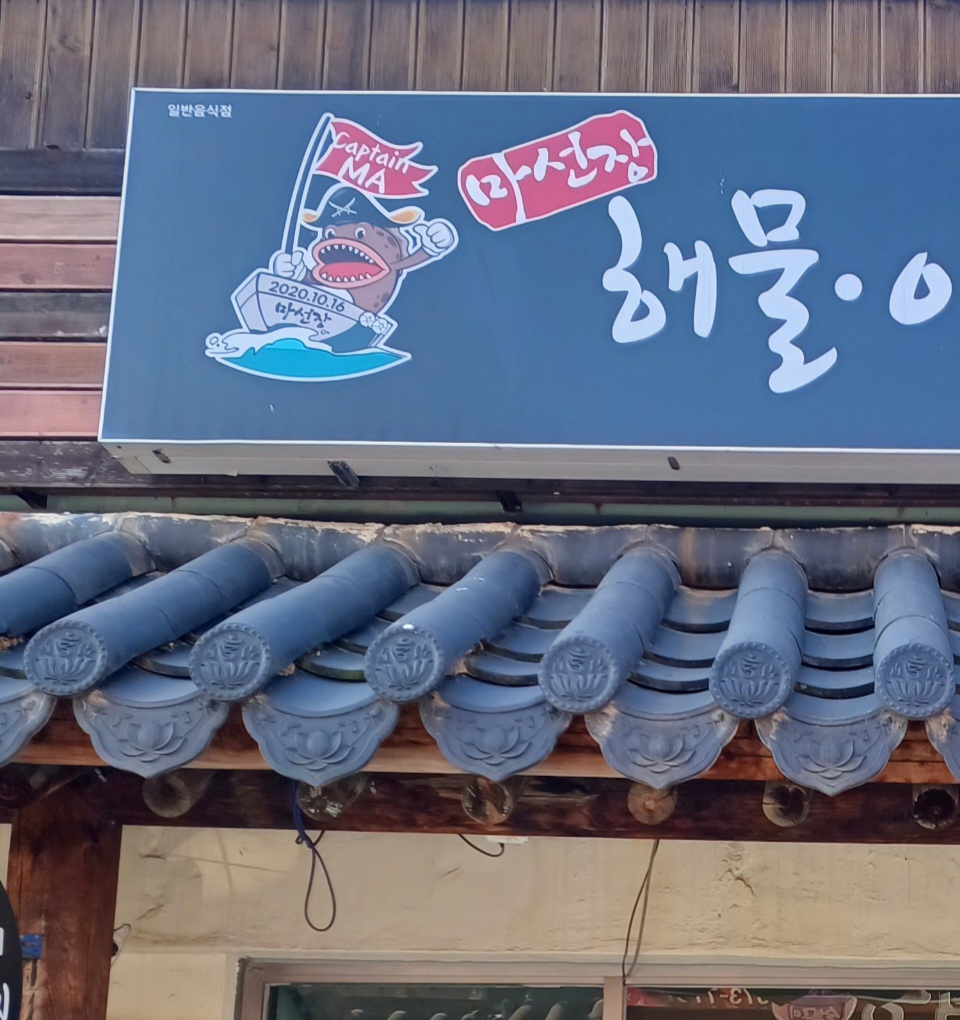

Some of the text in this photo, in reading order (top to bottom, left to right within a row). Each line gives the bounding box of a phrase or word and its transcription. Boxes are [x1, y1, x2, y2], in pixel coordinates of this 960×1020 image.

[167, 103, 232, 119] 일반음식점
[334, 131, 410, 174] Captain
[338, 156, 386, 194] MA
[465, 128, 652, 223] 마선장
[268, 281, 345, 312] 2020.10.16
[275, 302, 332, 328] 마선장
